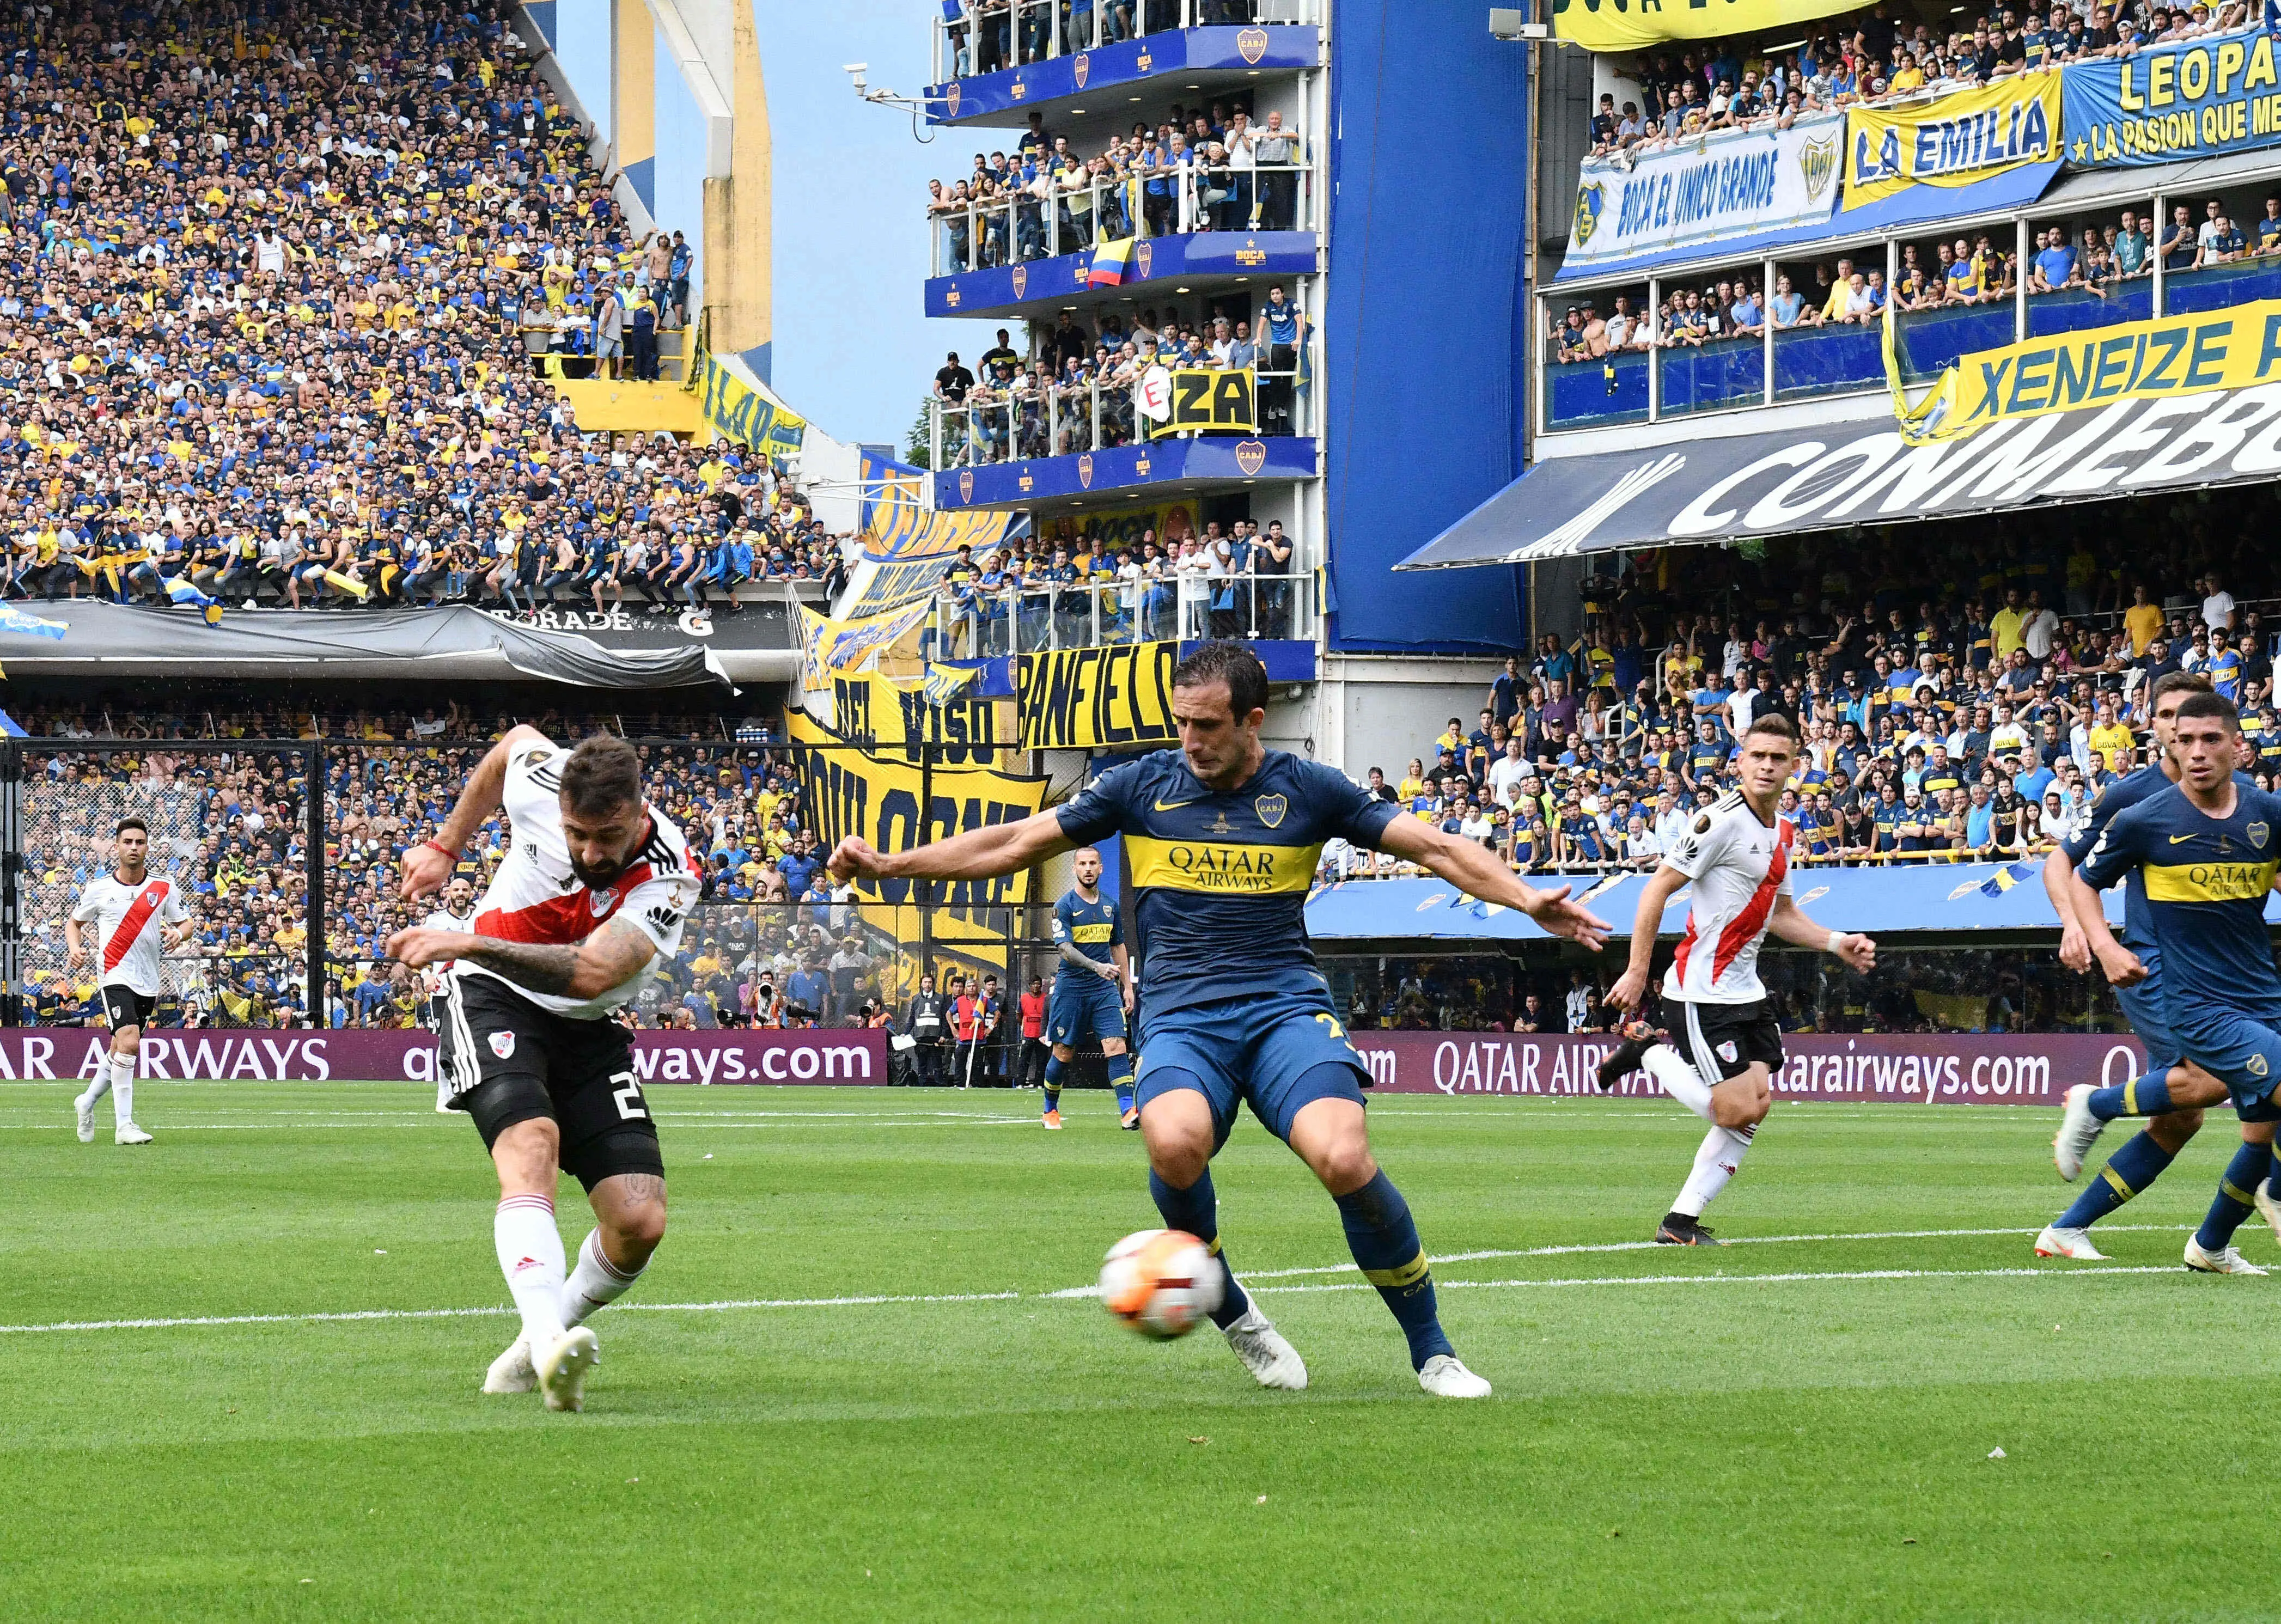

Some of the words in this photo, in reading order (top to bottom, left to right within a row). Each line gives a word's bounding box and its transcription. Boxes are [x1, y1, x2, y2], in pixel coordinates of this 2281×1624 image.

[2120, 36, 2278, 112] LEOPA
[1855, 127, 1903, 186] LA
[1912, 96, 2049, 178] EMILIA
[2091, 124, 2120, 162] LA
[2123, 109, 2197, 154] PASION
[2201, 100, 2247, 144] QUE
[1617, 174, 1656, 239] BOCA
[1655, 171, 1673, 229] EL
[1674, 160, 1719, 226] UNICO
[1718, 148, 1779, 213] GRANDE
[1235, 249, 1266, 260] BOCA
[1963, 319, 2234, 423] XENEIZE
[1239, 451, 1265, 460] CABJ
[834, 676, 876, 758] DEL
[899, 688, 998, 764] VISO
[1260, 805, 1283, 813] CABJ
[1168, 846, 1274, 875] QATAR
[1194, 871, 1273, 890] AIRWAYS
[2189, 866, 2261, 887] QATAR
[1080, 926, 1111, 937] QATAR
[76, 1037, 330, 1081] ARWAYS
[1433, 1041, 1541, 1095] QATAR
